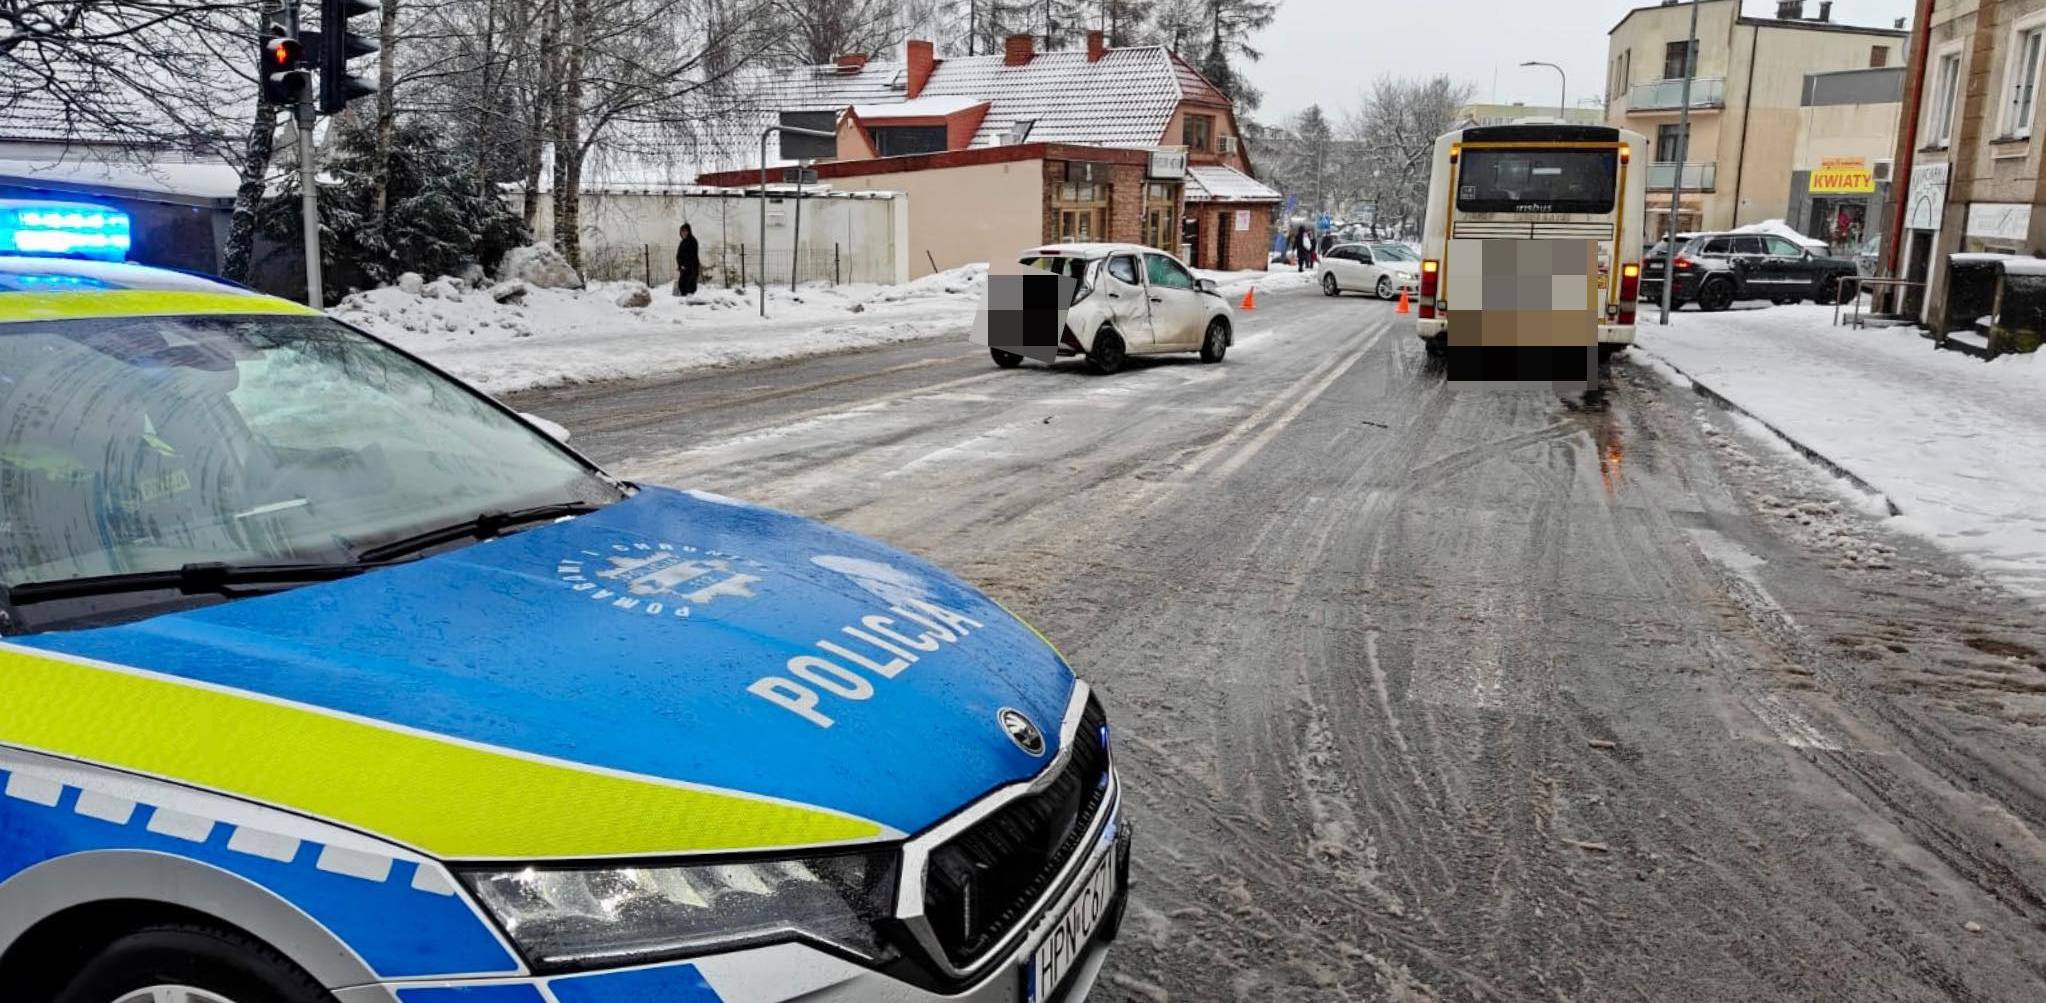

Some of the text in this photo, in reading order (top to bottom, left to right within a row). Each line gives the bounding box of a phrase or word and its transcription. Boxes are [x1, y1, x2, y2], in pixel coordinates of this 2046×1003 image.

[1813, 174, 1872, 188] KWIATY
[745, 598, 985, 729] POLICJA
[1041, 905, 1077, 999] HPN
